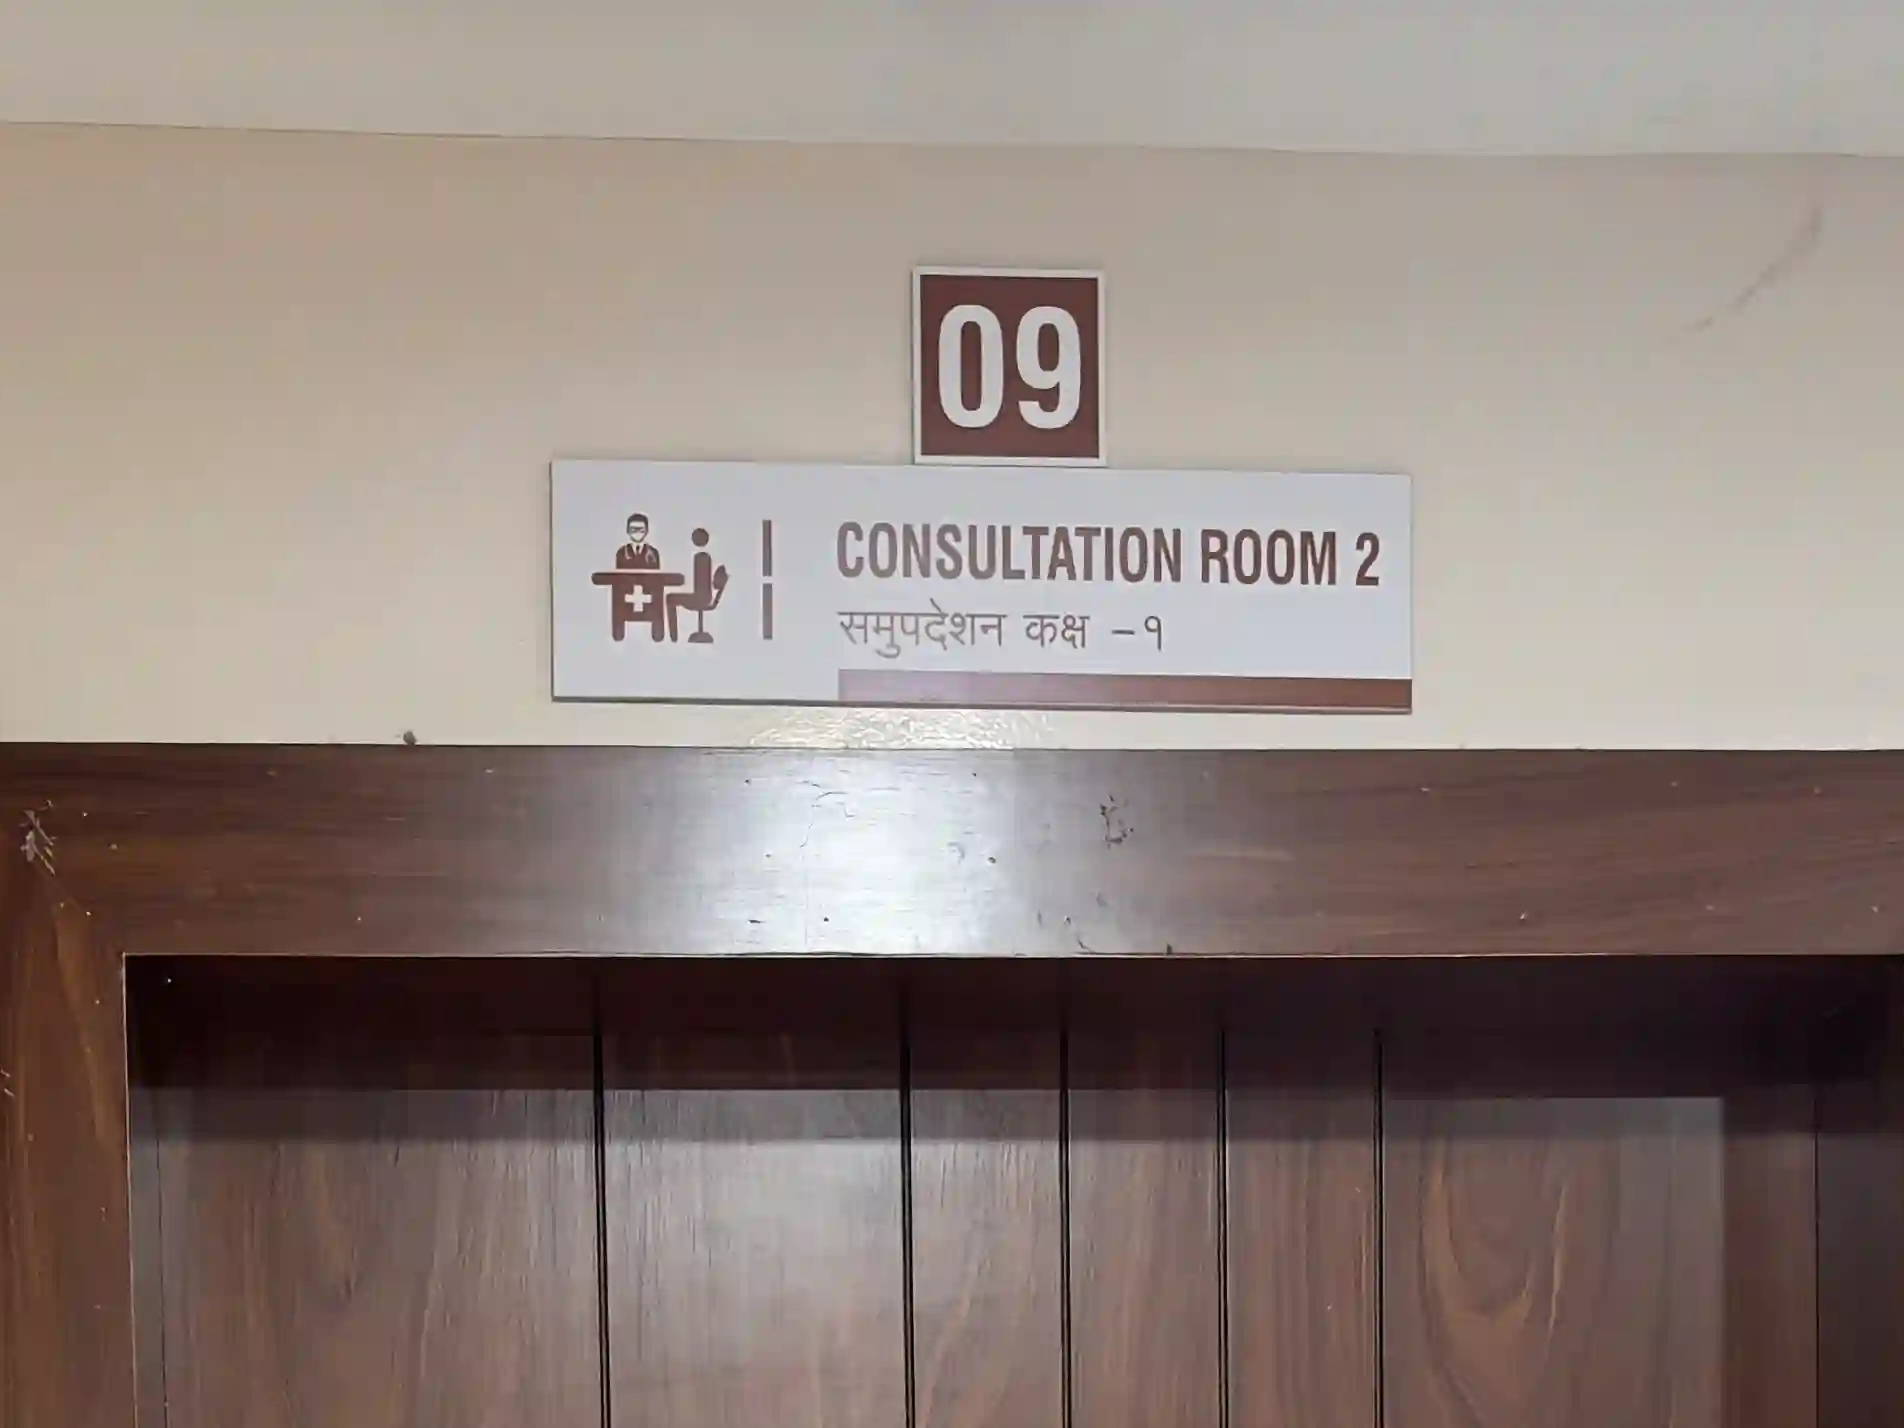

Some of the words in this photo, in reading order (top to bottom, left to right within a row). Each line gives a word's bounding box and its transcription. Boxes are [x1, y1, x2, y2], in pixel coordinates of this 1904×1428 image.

[938, 305, 1082, 429] 09
[837, 522, 1182, 582] CONSULTATION
[1201, 528, 1338, 587] ROOM
[1355, 532, 1380, 587] 2
[837, 598, 1007, 659] समुपदेशन
[1023, 613, 1090, 649] कक्ष
